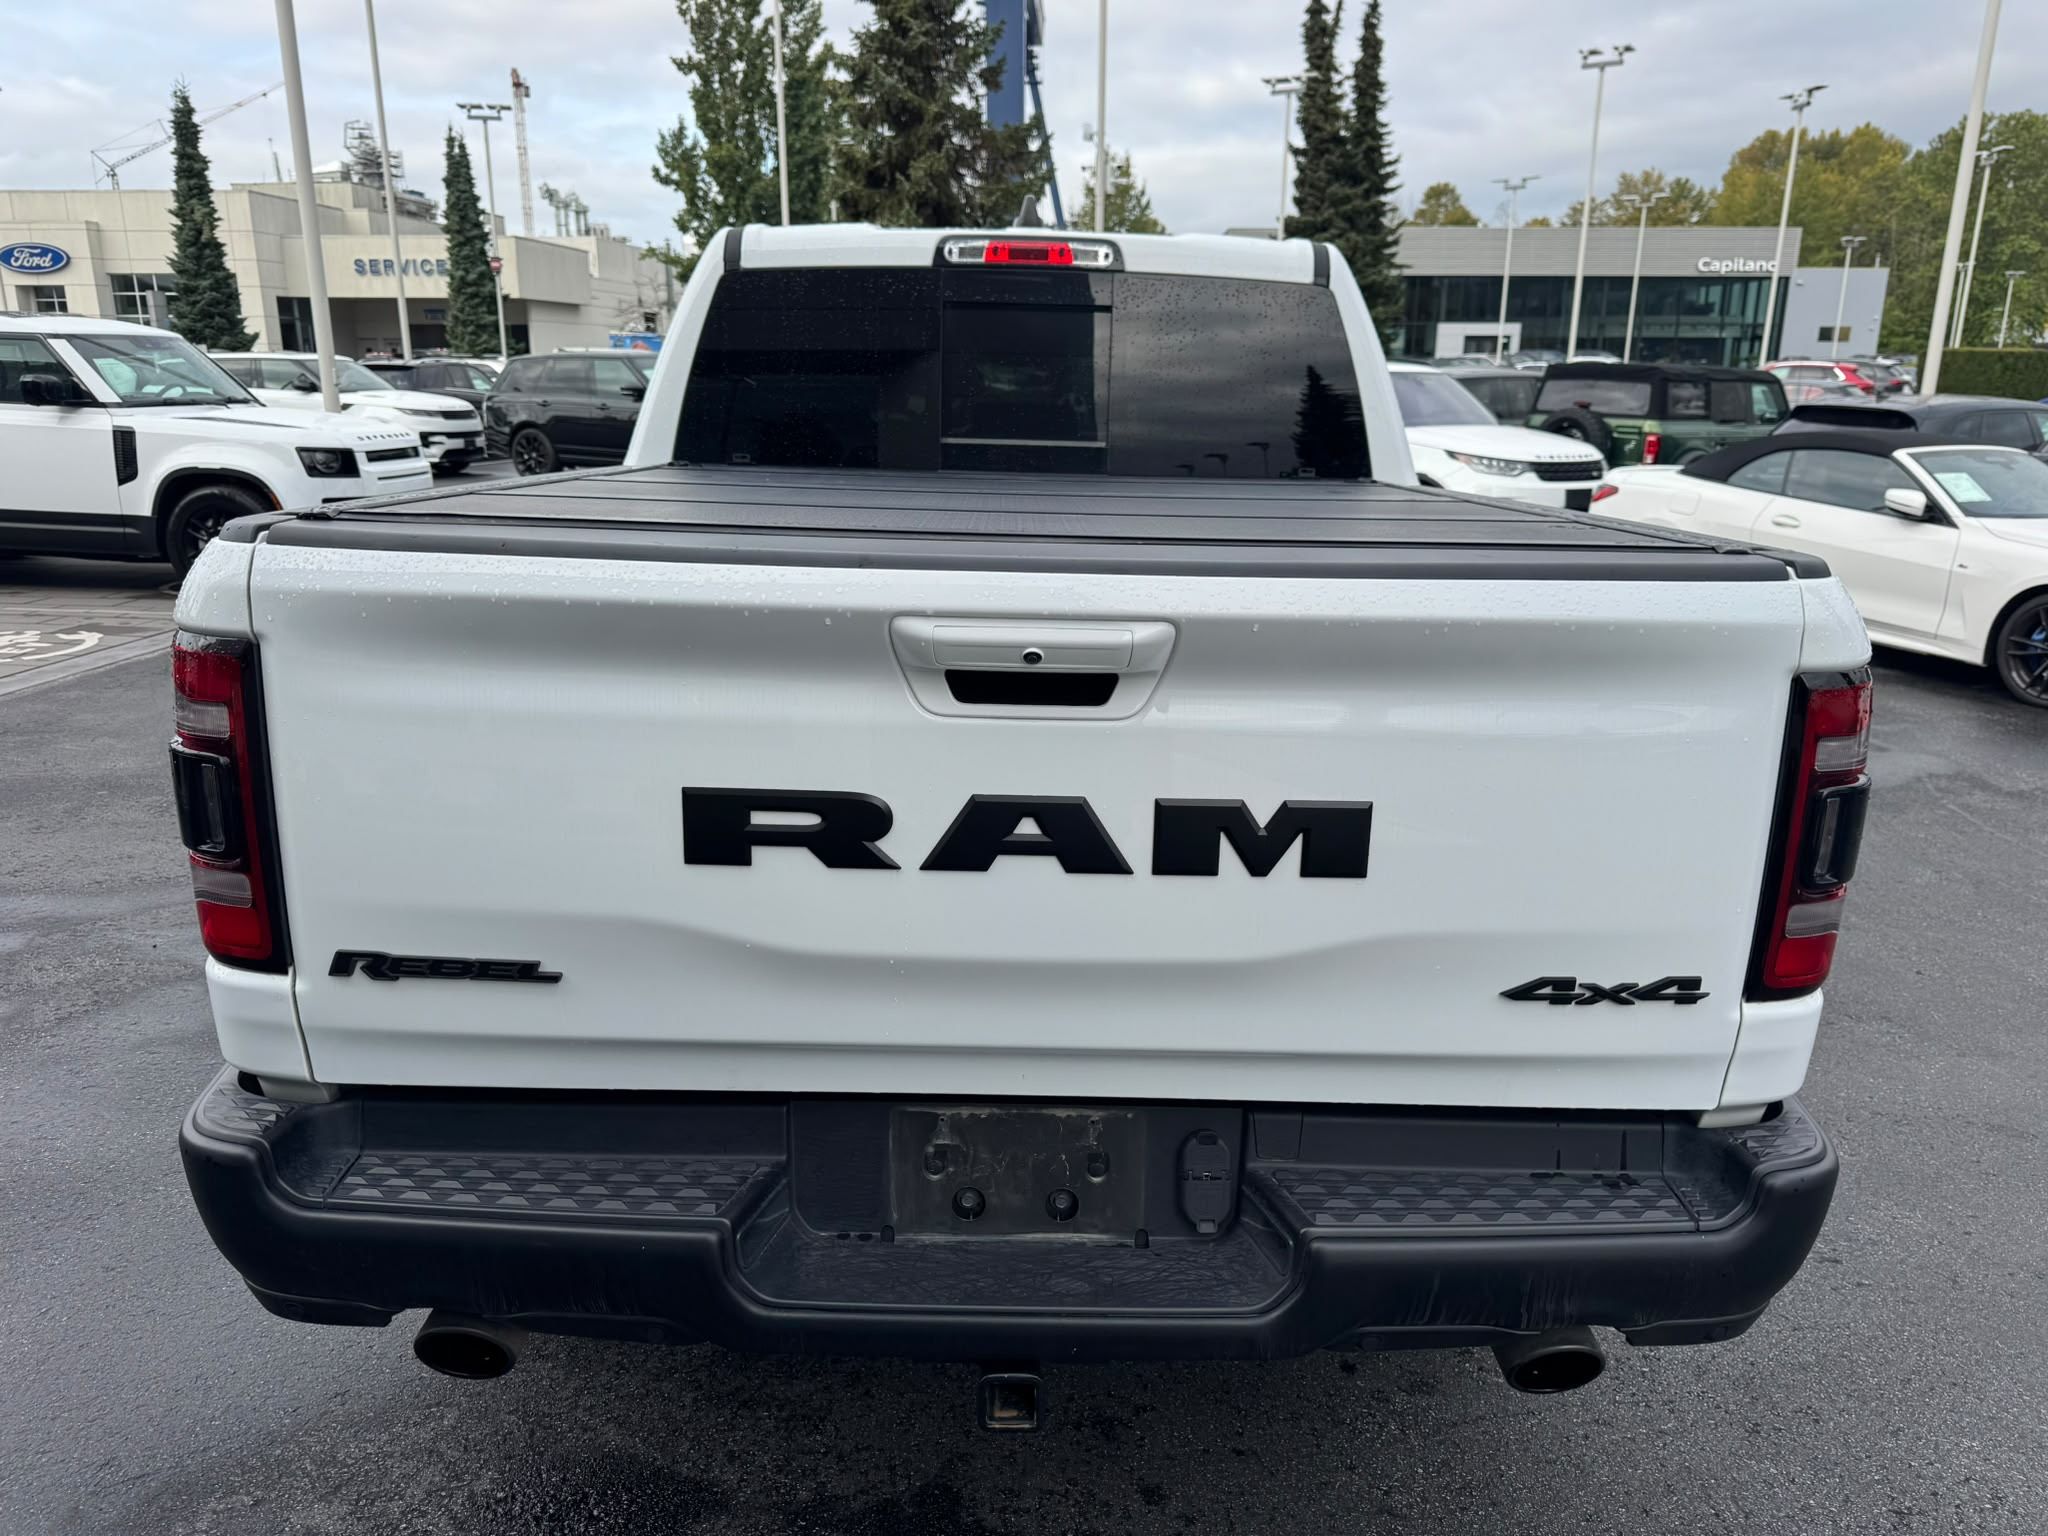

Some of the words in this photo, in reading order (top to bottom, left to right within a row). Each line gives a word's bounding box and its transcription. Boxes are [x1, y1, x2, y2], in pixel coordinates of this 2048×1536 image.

[10, 247, 54, 268] Ford
[353, 258, 449, 277] SERVICE
[681, 786, 1374, 879] RAM
[328, 949, 564, 984] REBEL
[1499, 975, 1711, 1006] 4x4
